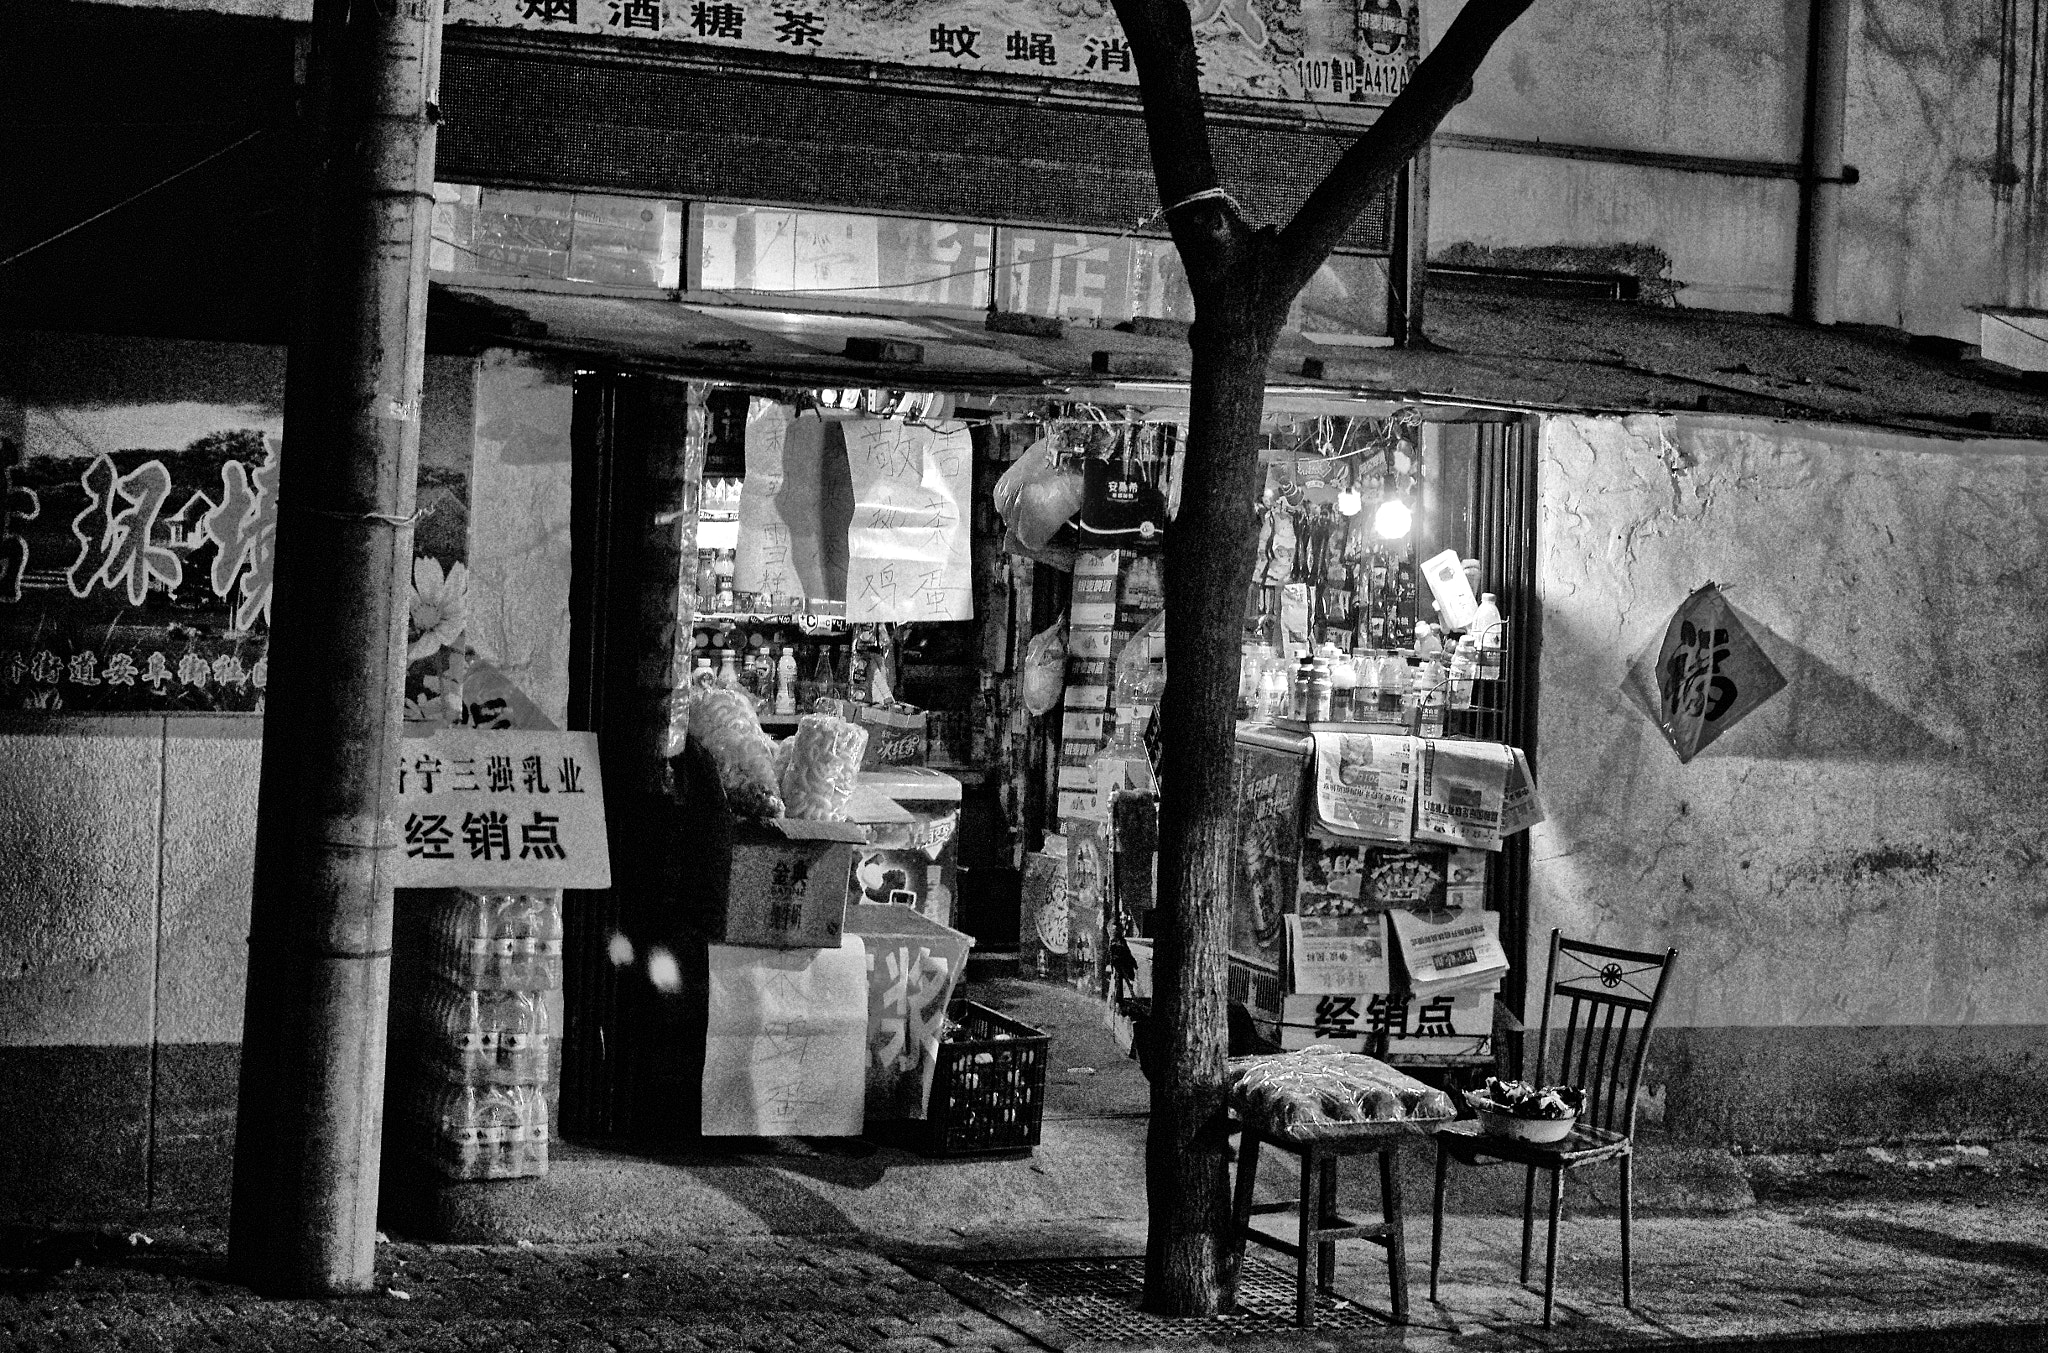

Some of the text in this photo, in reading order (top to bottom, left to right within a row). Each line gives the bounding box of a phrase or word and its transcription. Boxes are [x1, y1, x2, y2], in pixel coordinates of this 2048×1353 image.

[522, 0, 826, 47] 烟酒糖茶
[929, 23, 1206, 77] 蚊蝇消
[859, 563, 973, 621] 鸡蛋
[1664, 618, 1739, 723] 福
[403, 810, 567, 861] 经销点
[1314, 994, 1456, 1041] 经销点
